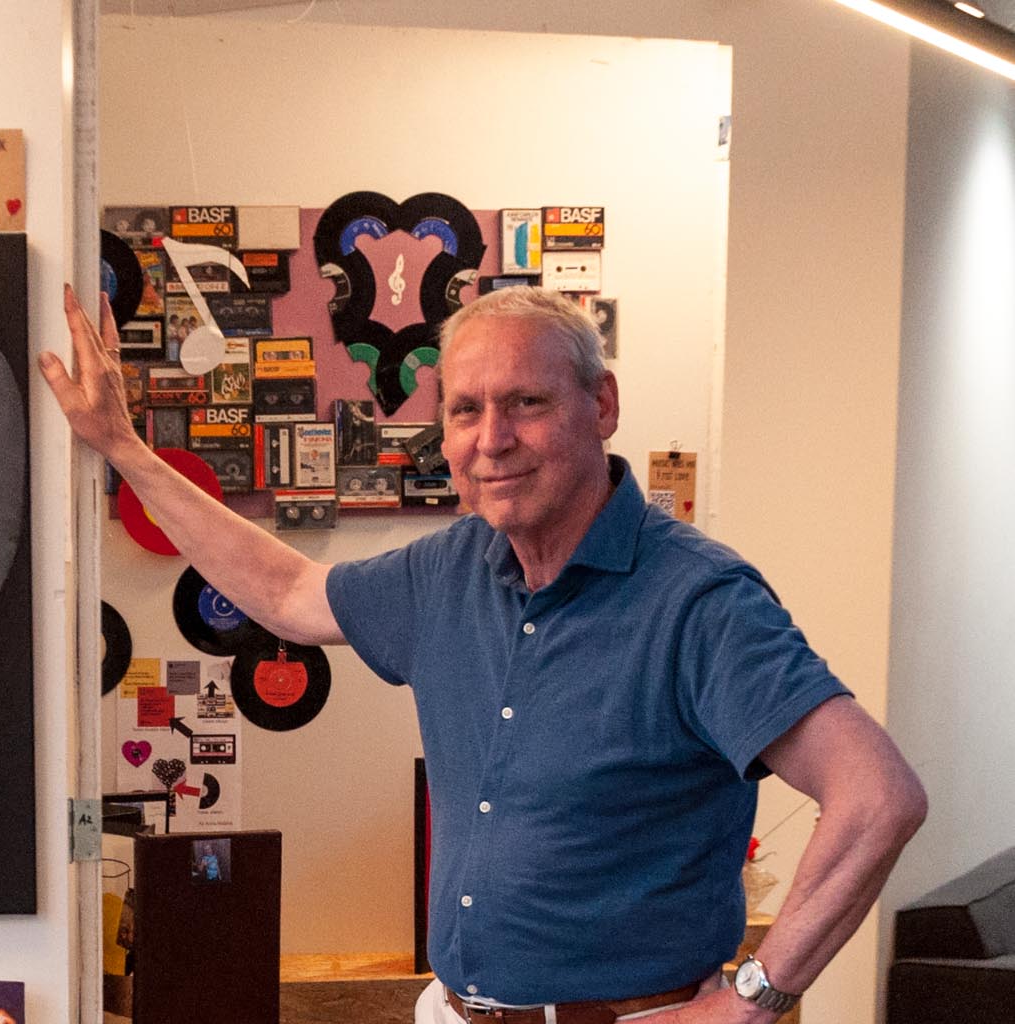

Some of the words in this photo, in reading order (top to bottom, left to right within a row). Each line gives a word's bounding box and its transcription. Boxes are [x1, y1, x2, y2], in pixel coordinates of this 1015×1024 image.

[188, 207, 231, 223] BASF
[560, 207, 602, 223] BASF
[213, 223, 231, 236] 60
[585, 223, 602, 235] 60
[188, 391, 207, 404] 60
[206, 408, 249, 424] BASF
[231, 423, 249, 436] 60
[78, 813, 93, 826] A2
